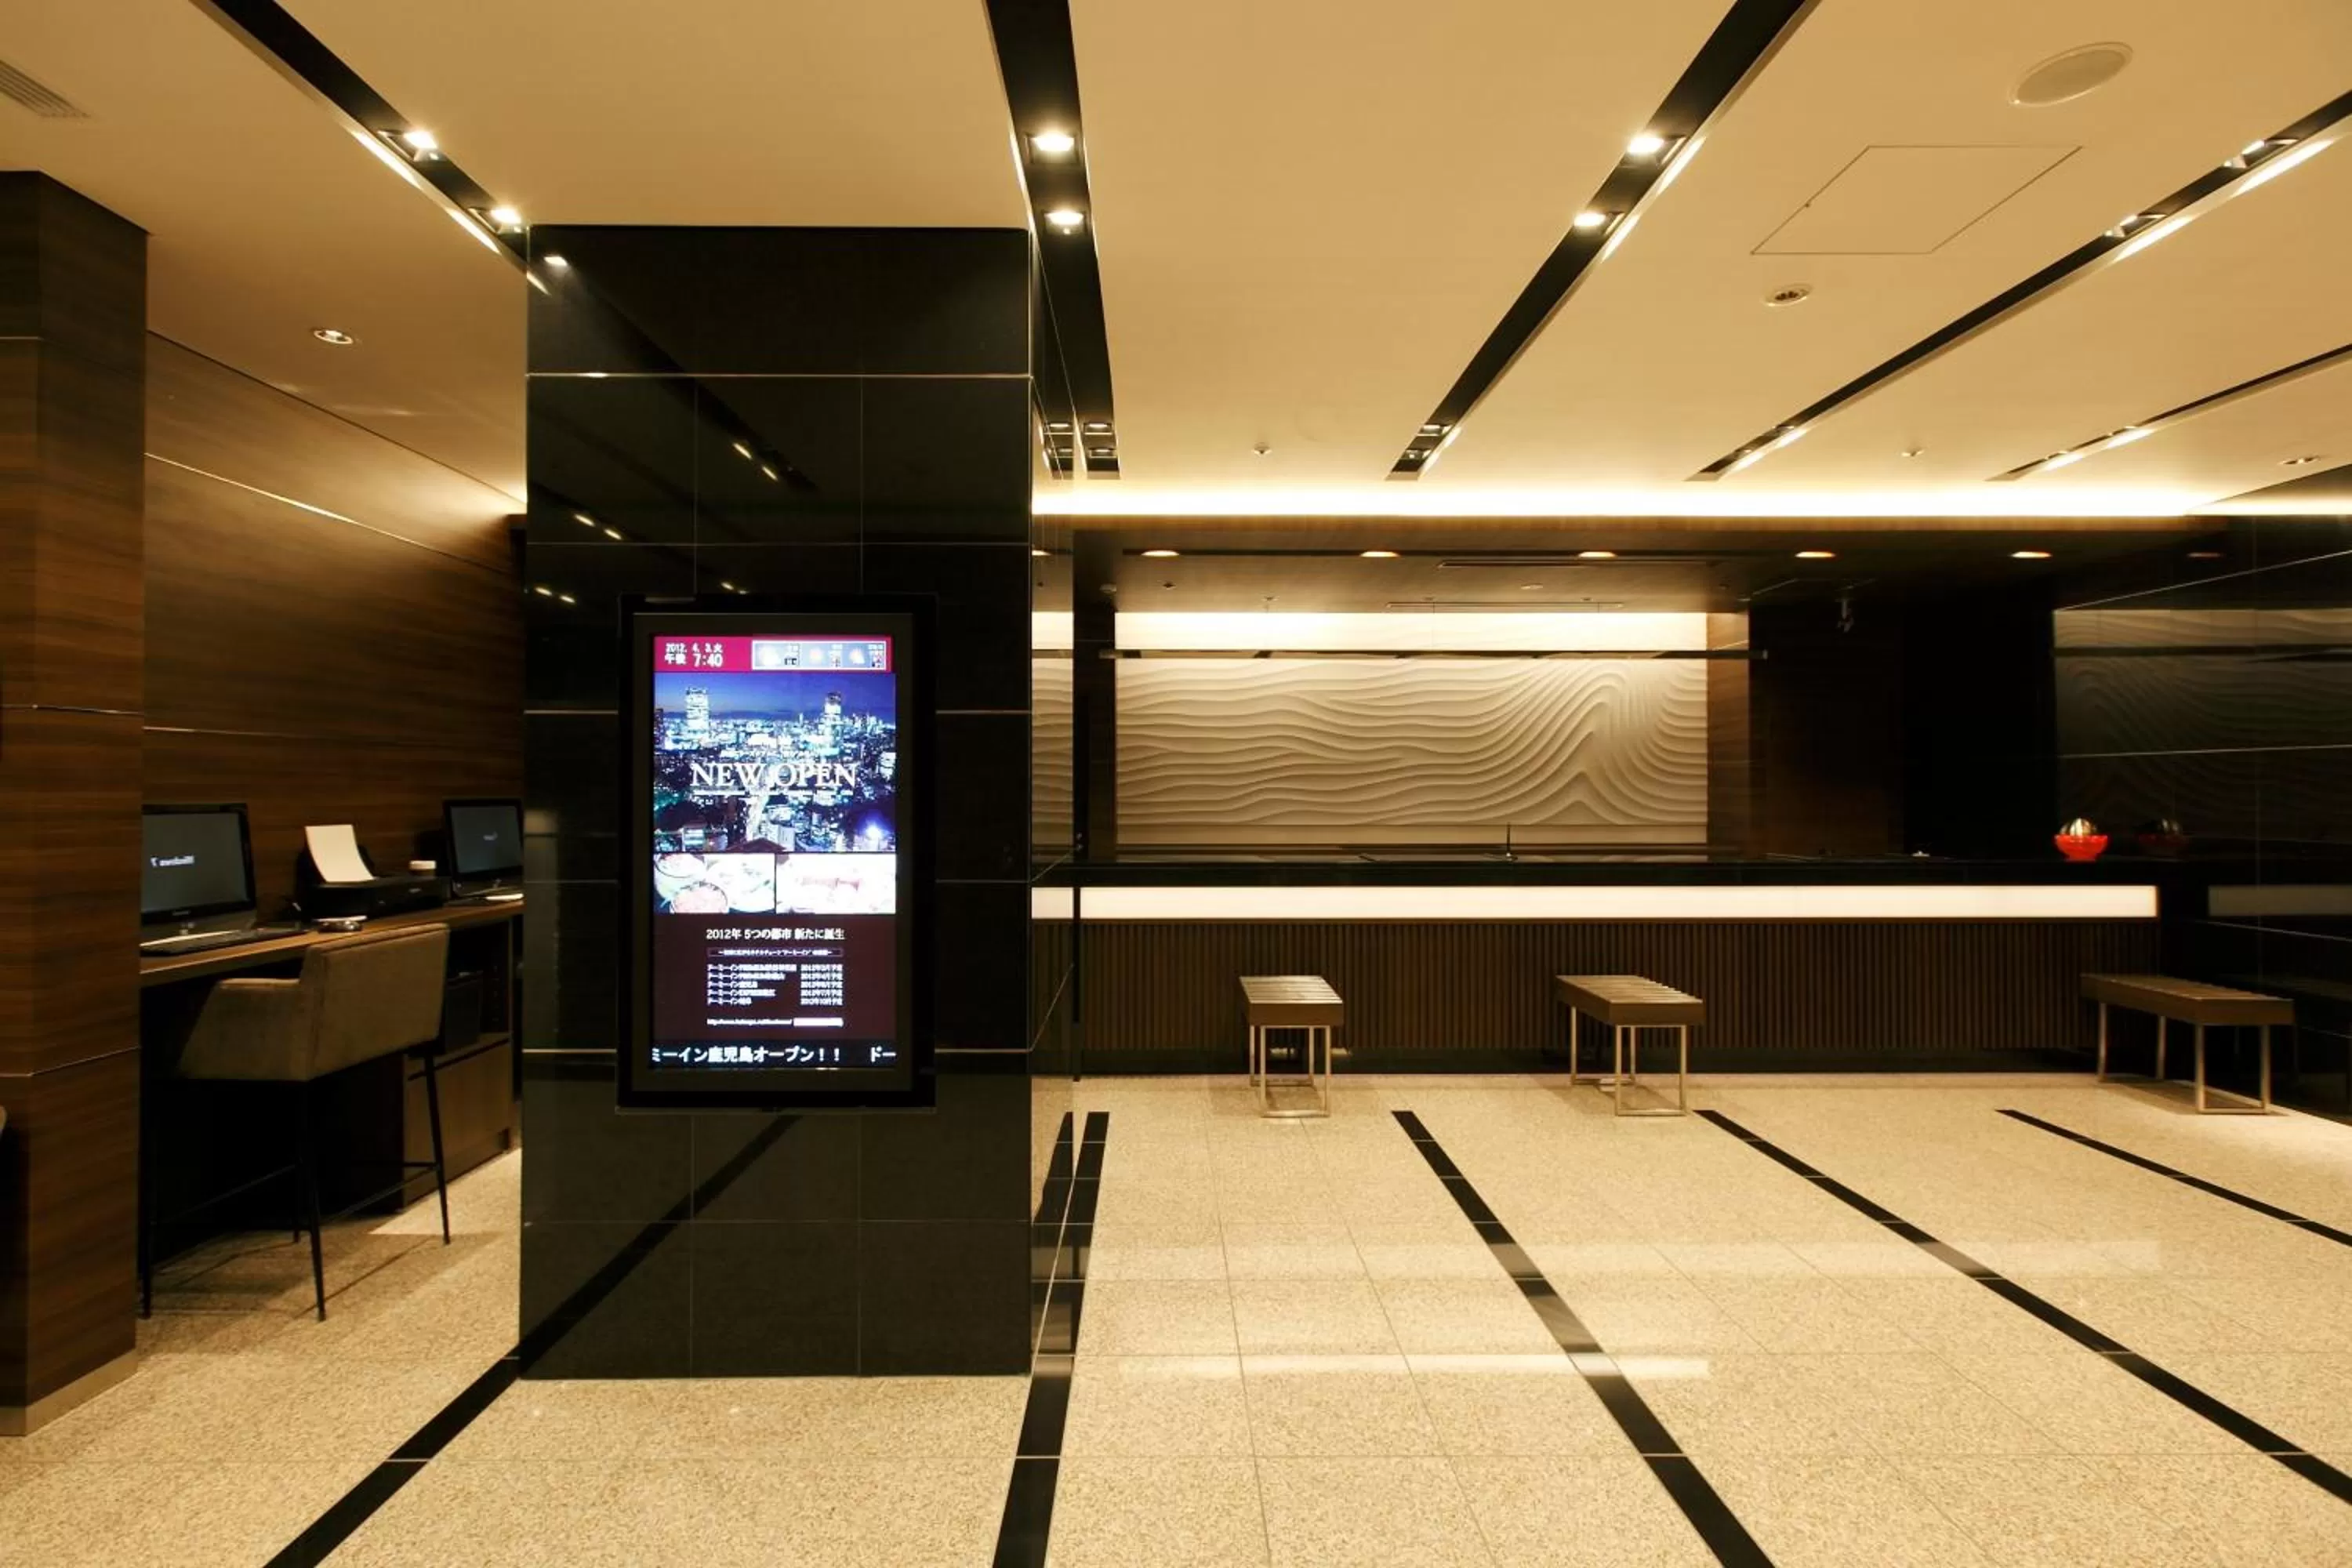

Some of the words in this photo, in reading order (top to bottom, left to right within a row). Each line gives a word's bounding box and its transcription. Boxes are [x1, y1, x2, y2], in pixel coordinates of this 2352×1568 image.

[691, 653, 723, 667] 7:40
[690, 761, 767, 787] NEW
[773, 761, 860, 789] OPEN
[706, 928, 742, 940] 2012年
